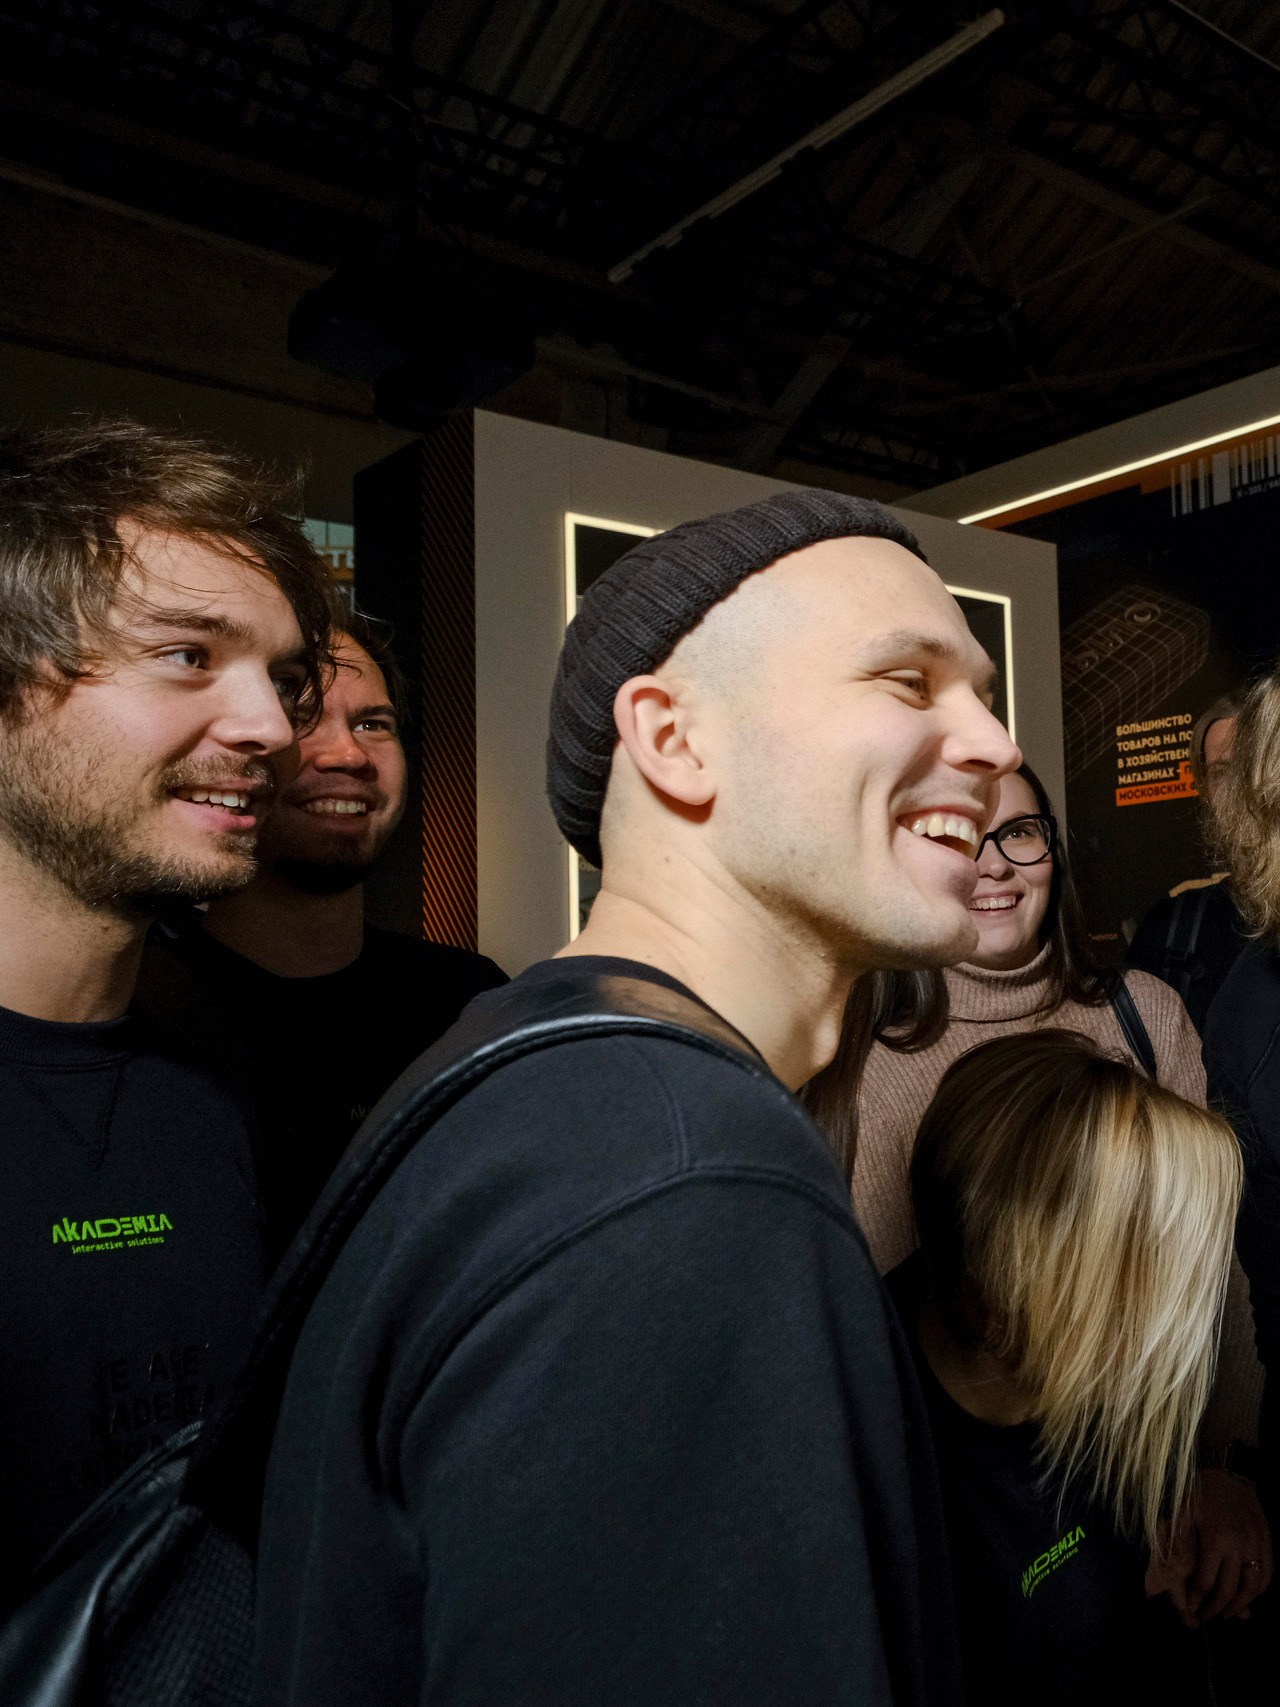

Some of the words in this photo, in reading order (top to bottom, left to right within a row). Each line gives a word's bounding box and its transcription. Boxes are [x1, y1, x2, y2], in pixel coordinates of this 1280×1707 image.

[1116, 714, 1192, 736] БОЛЬШИНСТВО
[1117, 736, 1161, 752] ТОВАРОВ
[1163, 733, 1177, 744] НА
[1179, 730, 1194, 742] ПО
[1118, 758, 1124, 769] В
[1126, 748, 1190, 767] ХОЗЯЙСТВЕН
[1118, 767, 1175, 785] МАГАЗИНАХ
[1119, 782, 1187, 800] МОСКОВСКИХ
[72, 1241, 124, 1254] interactive
[127, 1236, 164, 1248] solutions
